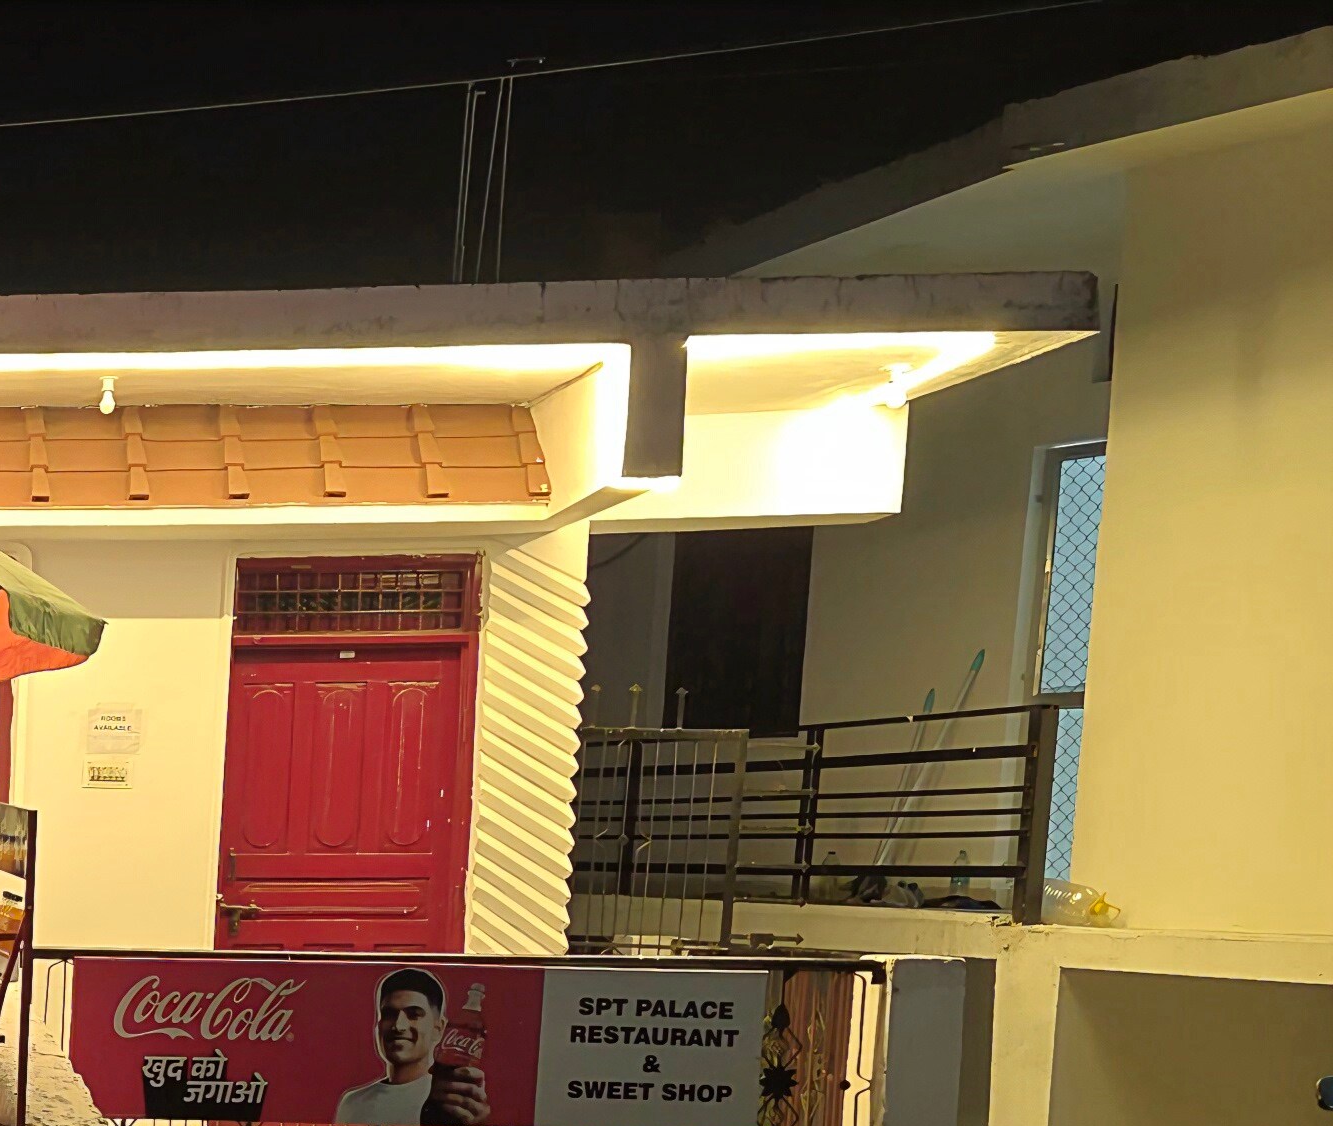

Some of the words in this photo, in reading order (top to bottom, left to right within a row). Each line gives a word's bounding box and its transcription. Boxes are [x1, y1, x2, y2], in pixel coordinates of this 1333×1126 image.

[113, 975, 307, 1041] Coca-Cola
[579, 997, 628, 1016] SPT
[635, 999, 734, 1020] PALACE
[570, 1025, 739, 1048] RESTAURANT
[142, 1055, 188, 1088] खुद
[191, 1048, 228, 1079] को
[642, 1055, 661, 1073] &
[183, 1072, 268, 1104] जगाओ
[567, 1080, 655, 1101] SWEET
[661, 1083, 733, 1103] SHOP
